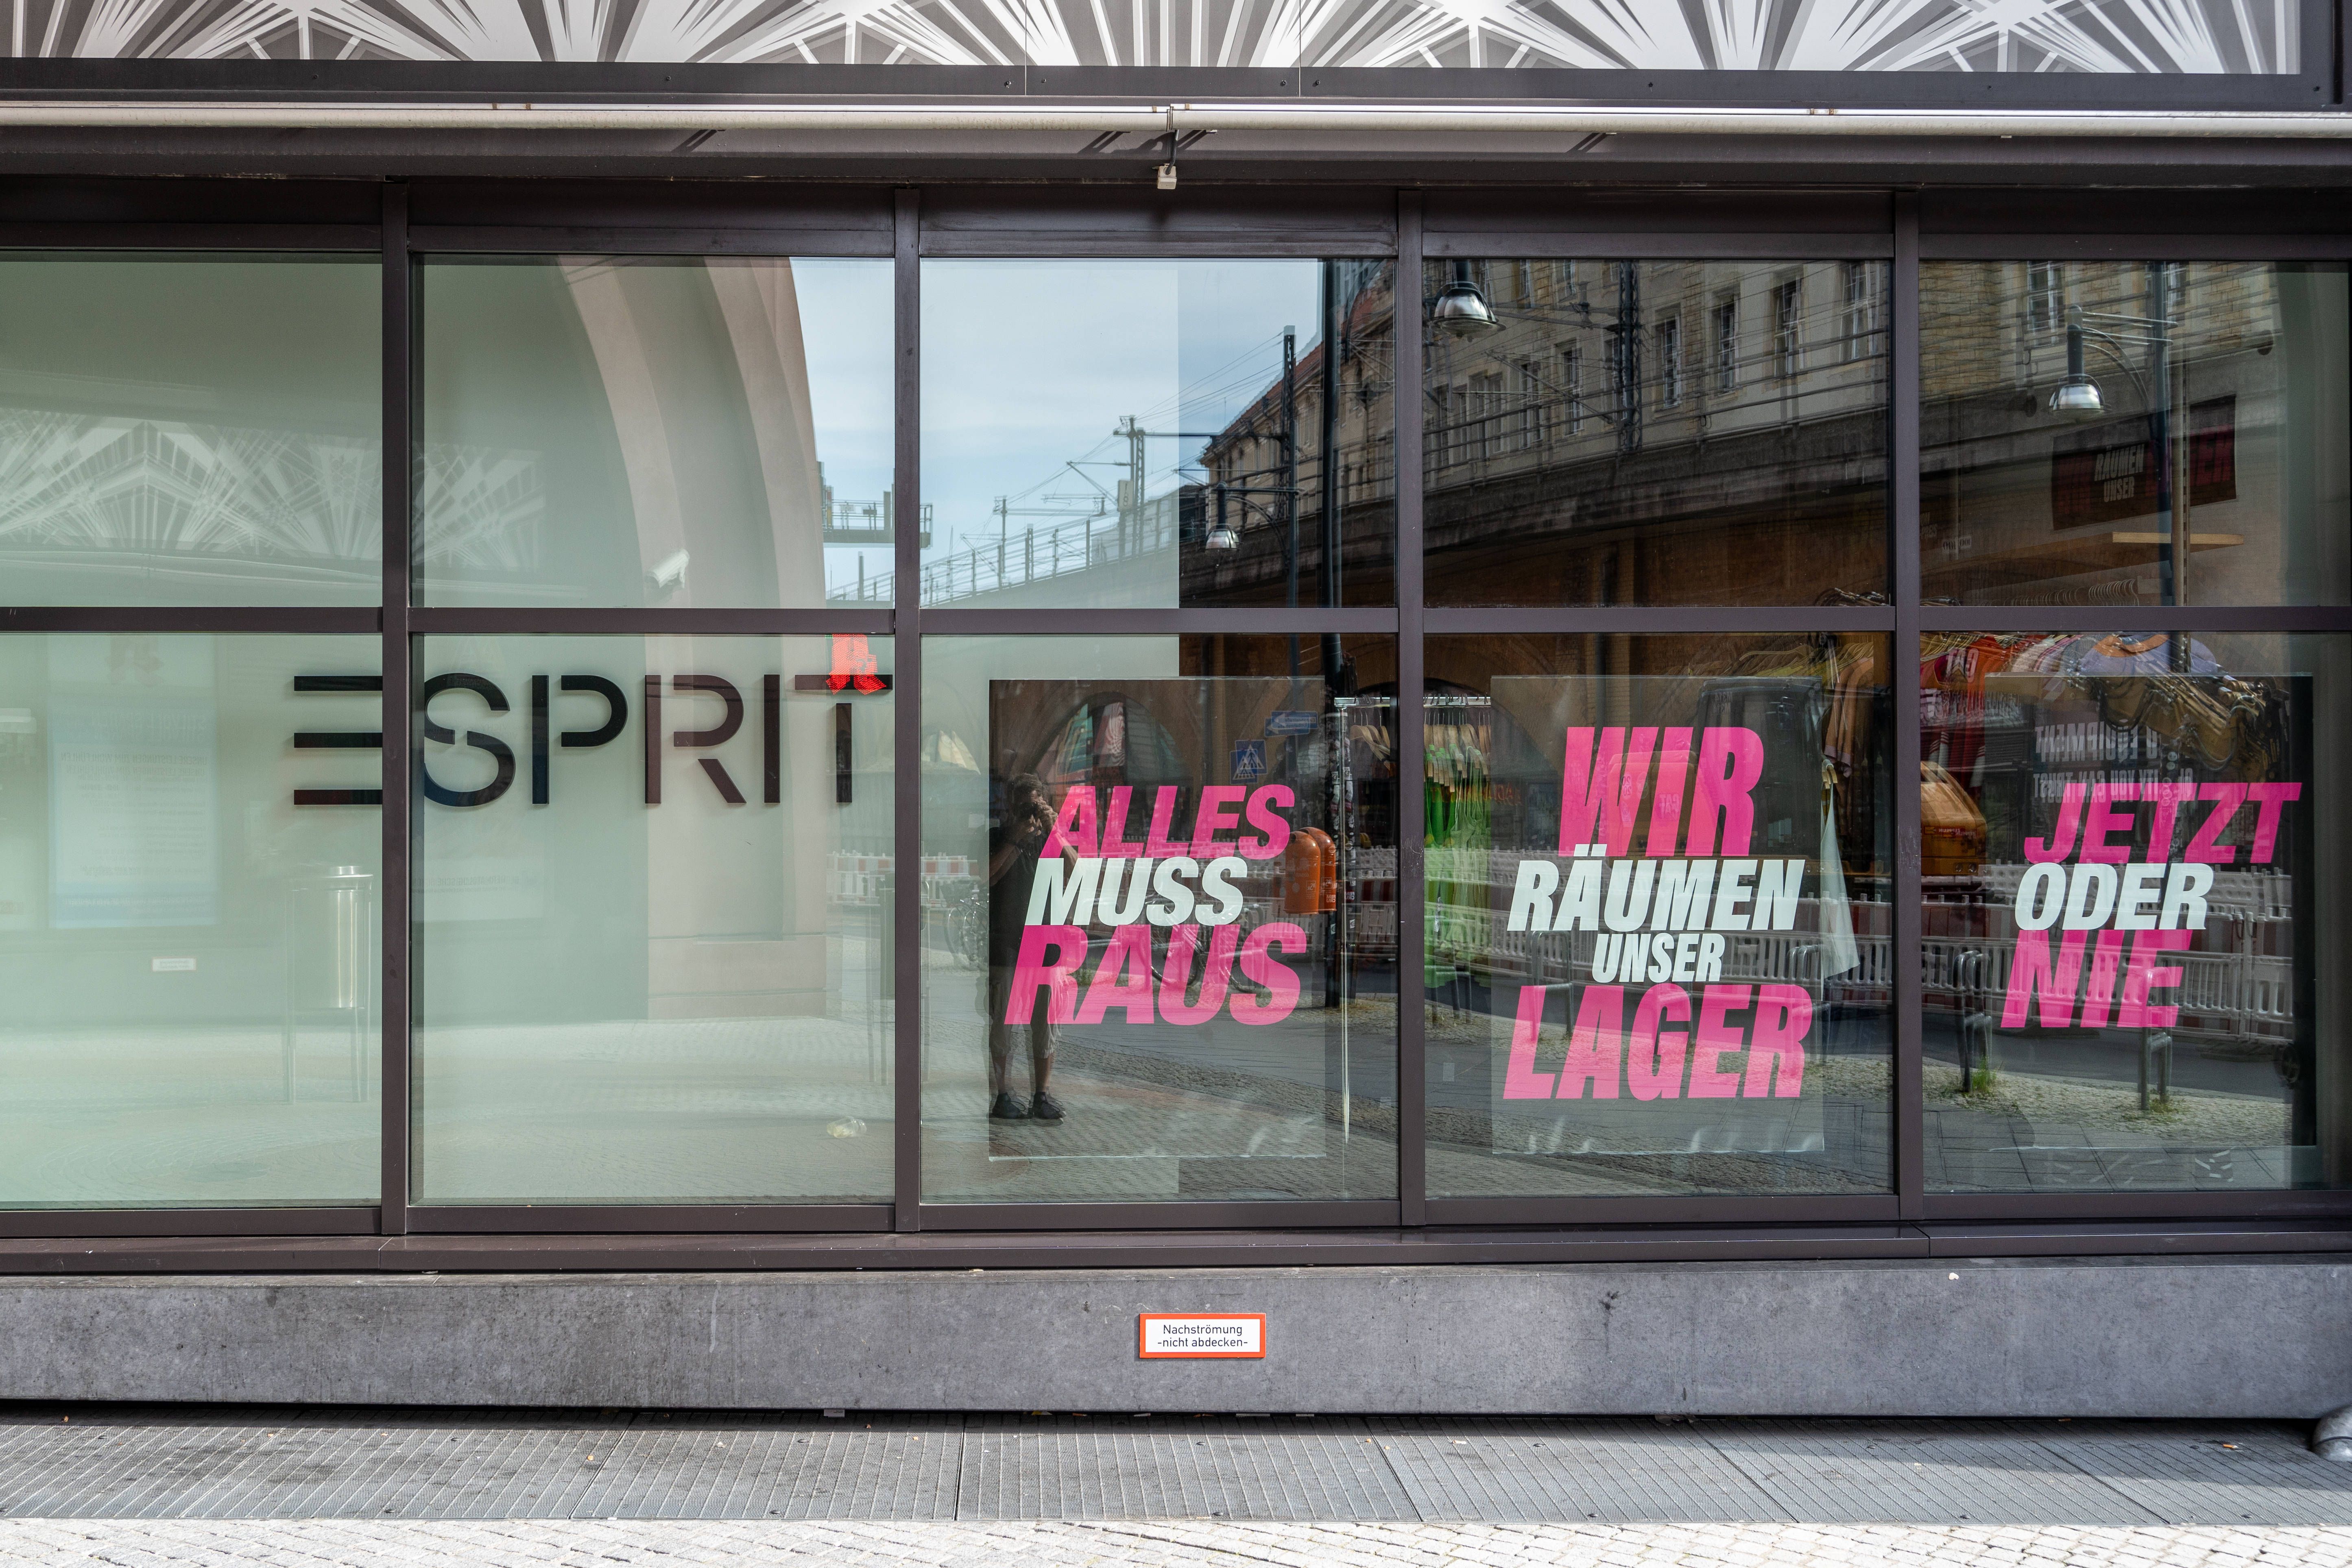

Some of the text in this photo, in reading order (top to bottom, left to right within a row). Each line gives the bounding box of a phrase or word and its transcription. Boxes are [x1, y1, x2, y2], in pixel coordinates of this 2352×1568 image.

[294, 673, 893, 808] ESPRIT
[1039, 784, 1295, 860] ALLES
[1558, 727, 1763, 857] WIR
[2024, 783, 2302, 864] JETZT
[1025, 857, 1248, 927] MUSS
[1507, 844, 1805, 931] RÄUMEN
[2015, 862, 2214, 930] ODER
[1005, 922, 1307, 1026] RAUS
[1592, 933, 1725, 983] UNSER
[2000, 929, 2194, 1028] NIE
[1503, 983, 1813, 1101] LAGER
[1157, 1337, 1248, 1347] -nicht abdecken-
[1163, 1324, 1242, 1336] Nachströmung
